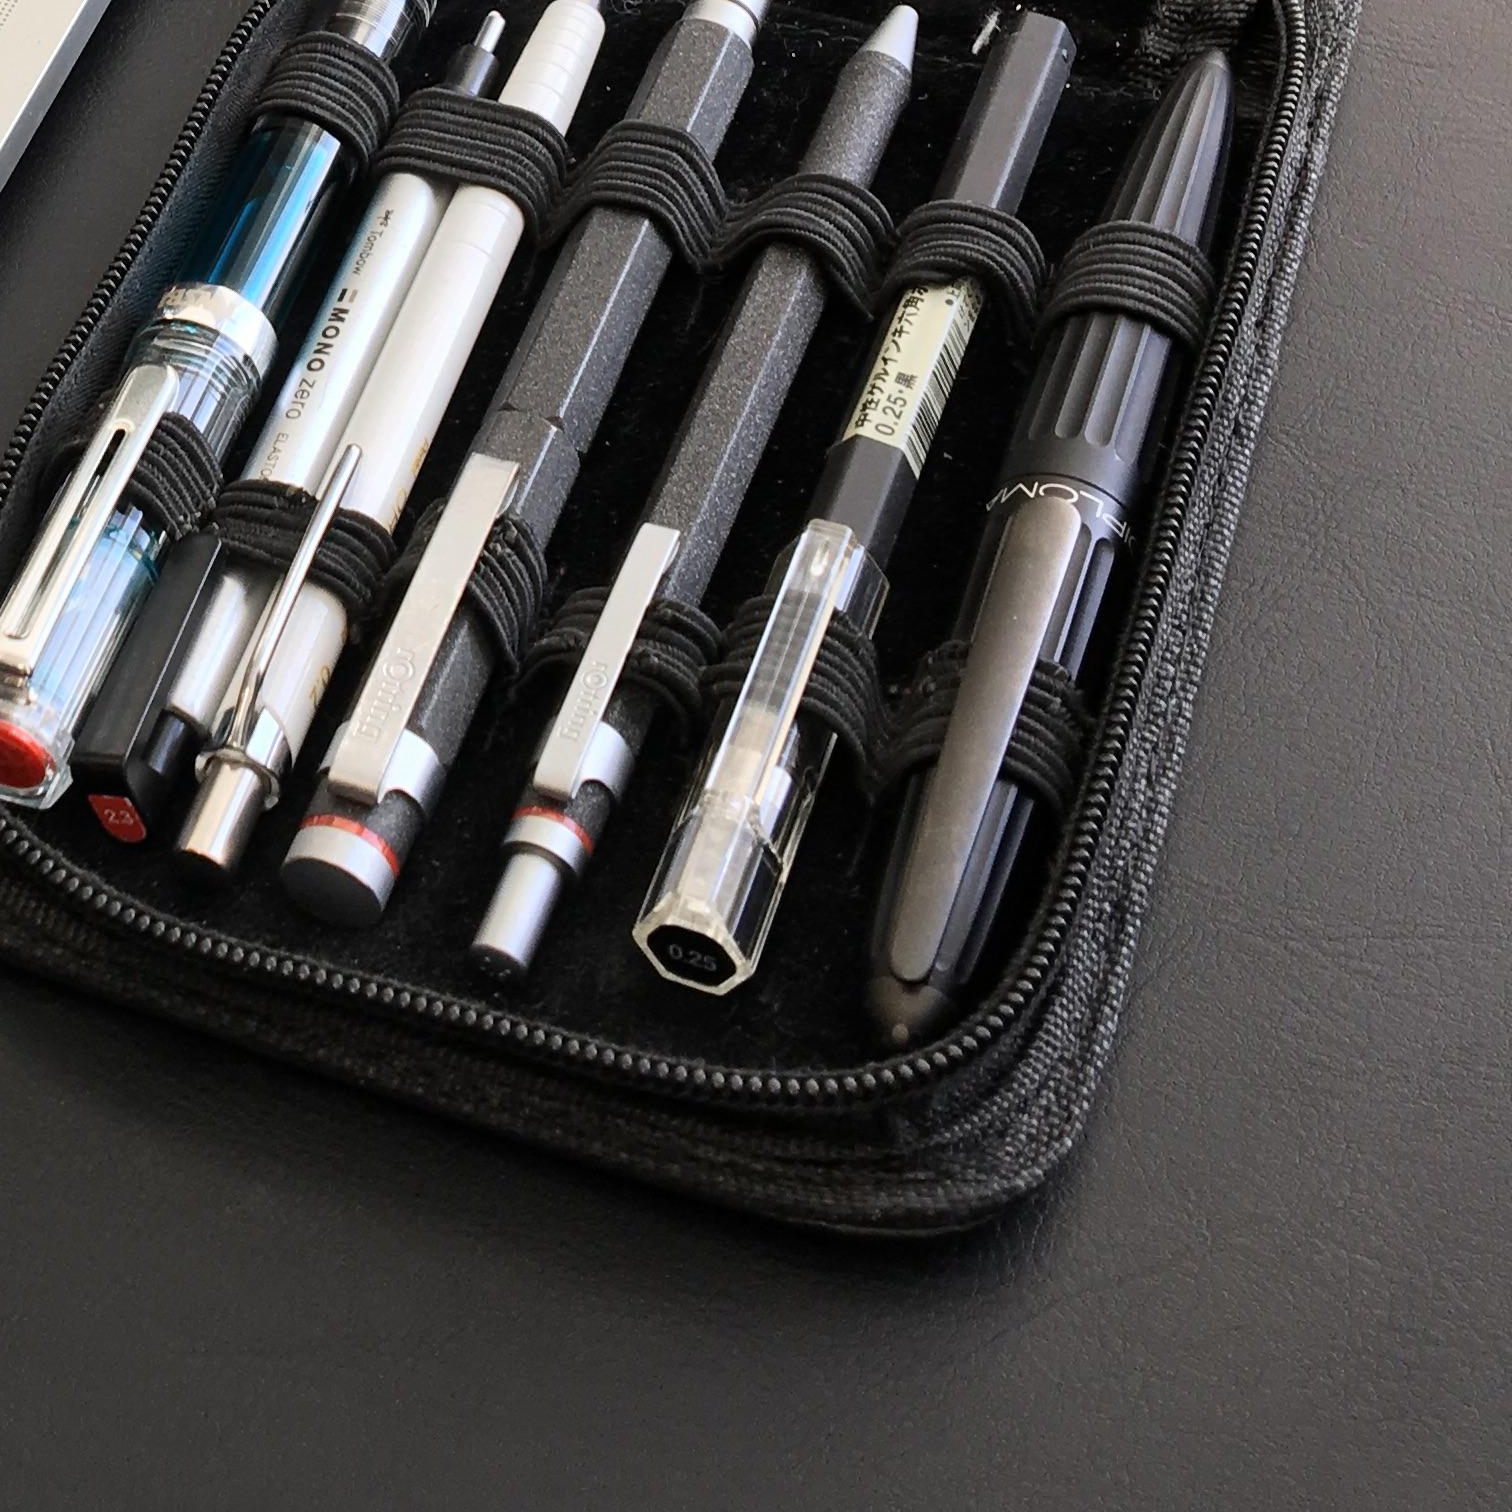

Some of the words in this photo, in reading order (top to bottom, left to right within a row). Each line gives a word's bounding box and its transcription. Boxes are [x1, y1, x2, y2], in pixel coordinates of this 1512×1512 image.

[352, 229, 384, 276] Tombow
[307, 308, 350, 373] MONO
[285, 378, 317, 420] zero
